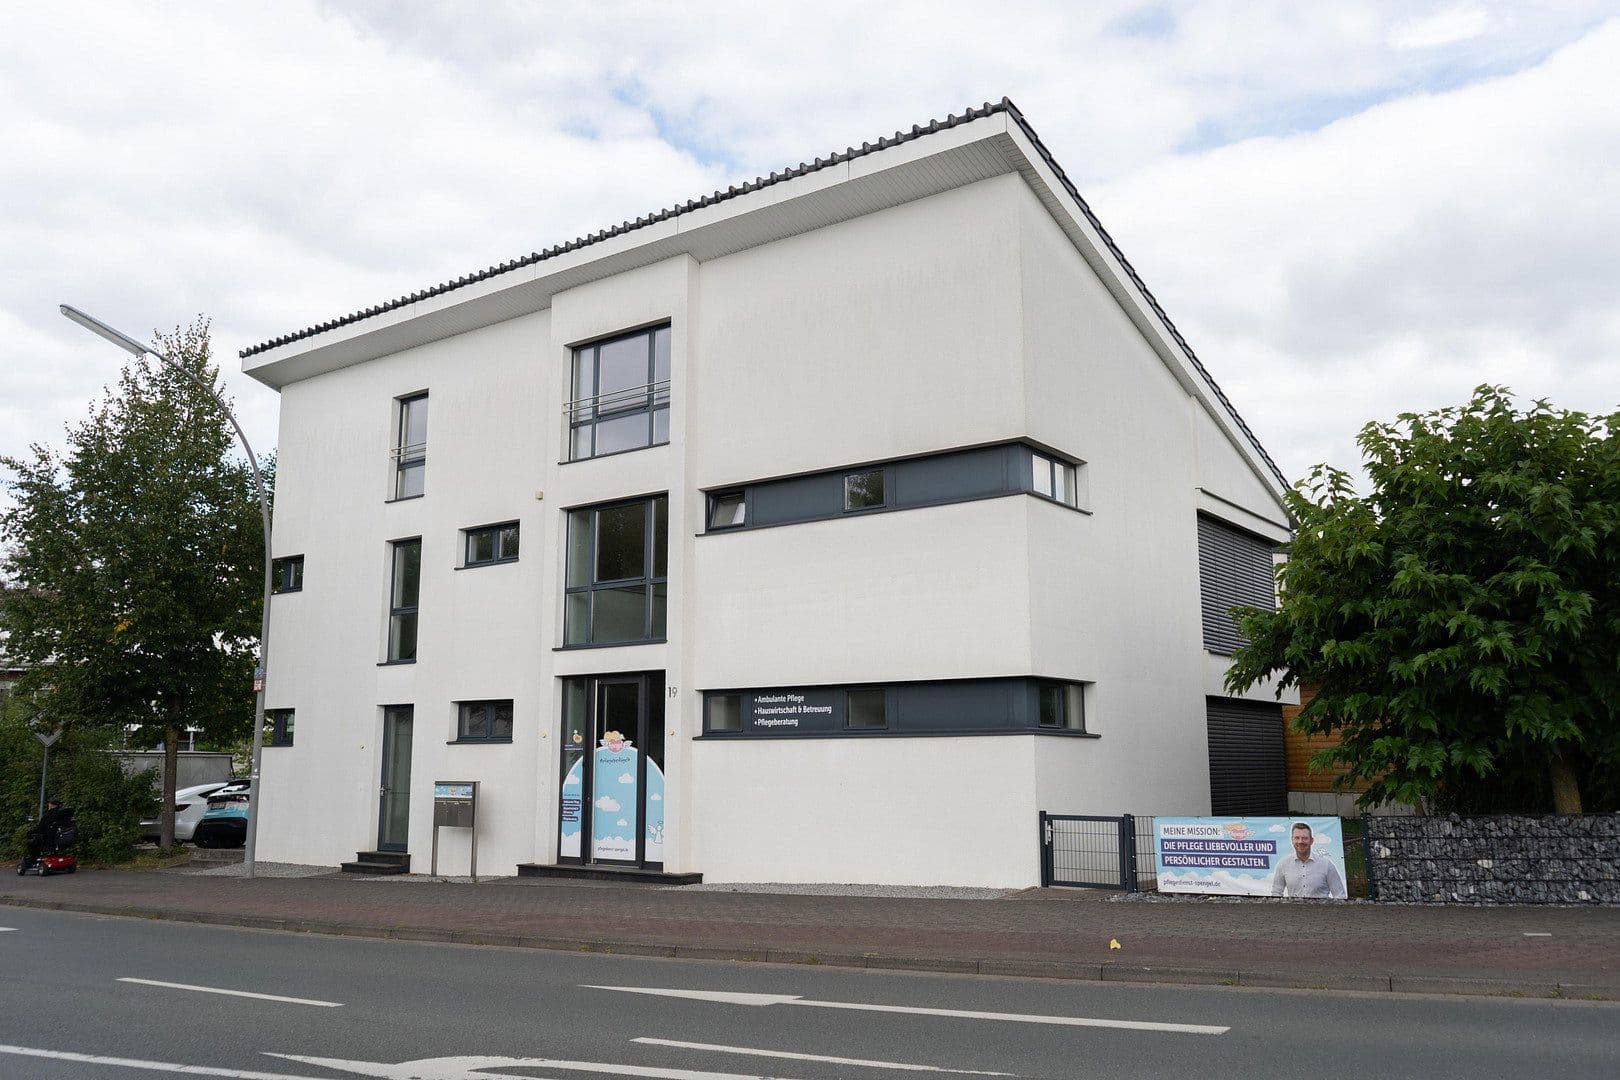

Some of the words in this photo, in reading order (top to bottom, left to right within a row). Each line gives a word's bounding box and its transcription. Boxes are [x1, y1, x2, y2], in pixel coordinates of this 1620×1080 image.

[668, 687, 678, 698] 19
[758, 695, 786, 703] Ambulante
[787, 694, 805, 703] Pflege
[758, 706, 797, 714] Hauswirtschaft
[803, 705, 832, 714] Betreuung
[758, 718, 799, 727] Pflegeberatung
[1163, 827, 1186, 836] MEINE
[1187, 827, 1221, 836] MISSION:
[1163, 841, 1176, 850] DIE
[1177, 841, 1204, 851] PFLEGE
[1205, 842, 1254, 852] LIEBEVOLLER
[1255, 842, 1273, 852] UND
[1164, 855, 1220, 866] PERSÖNLICHER
[1221, 857, 1266, 867] GESTALTEN.
